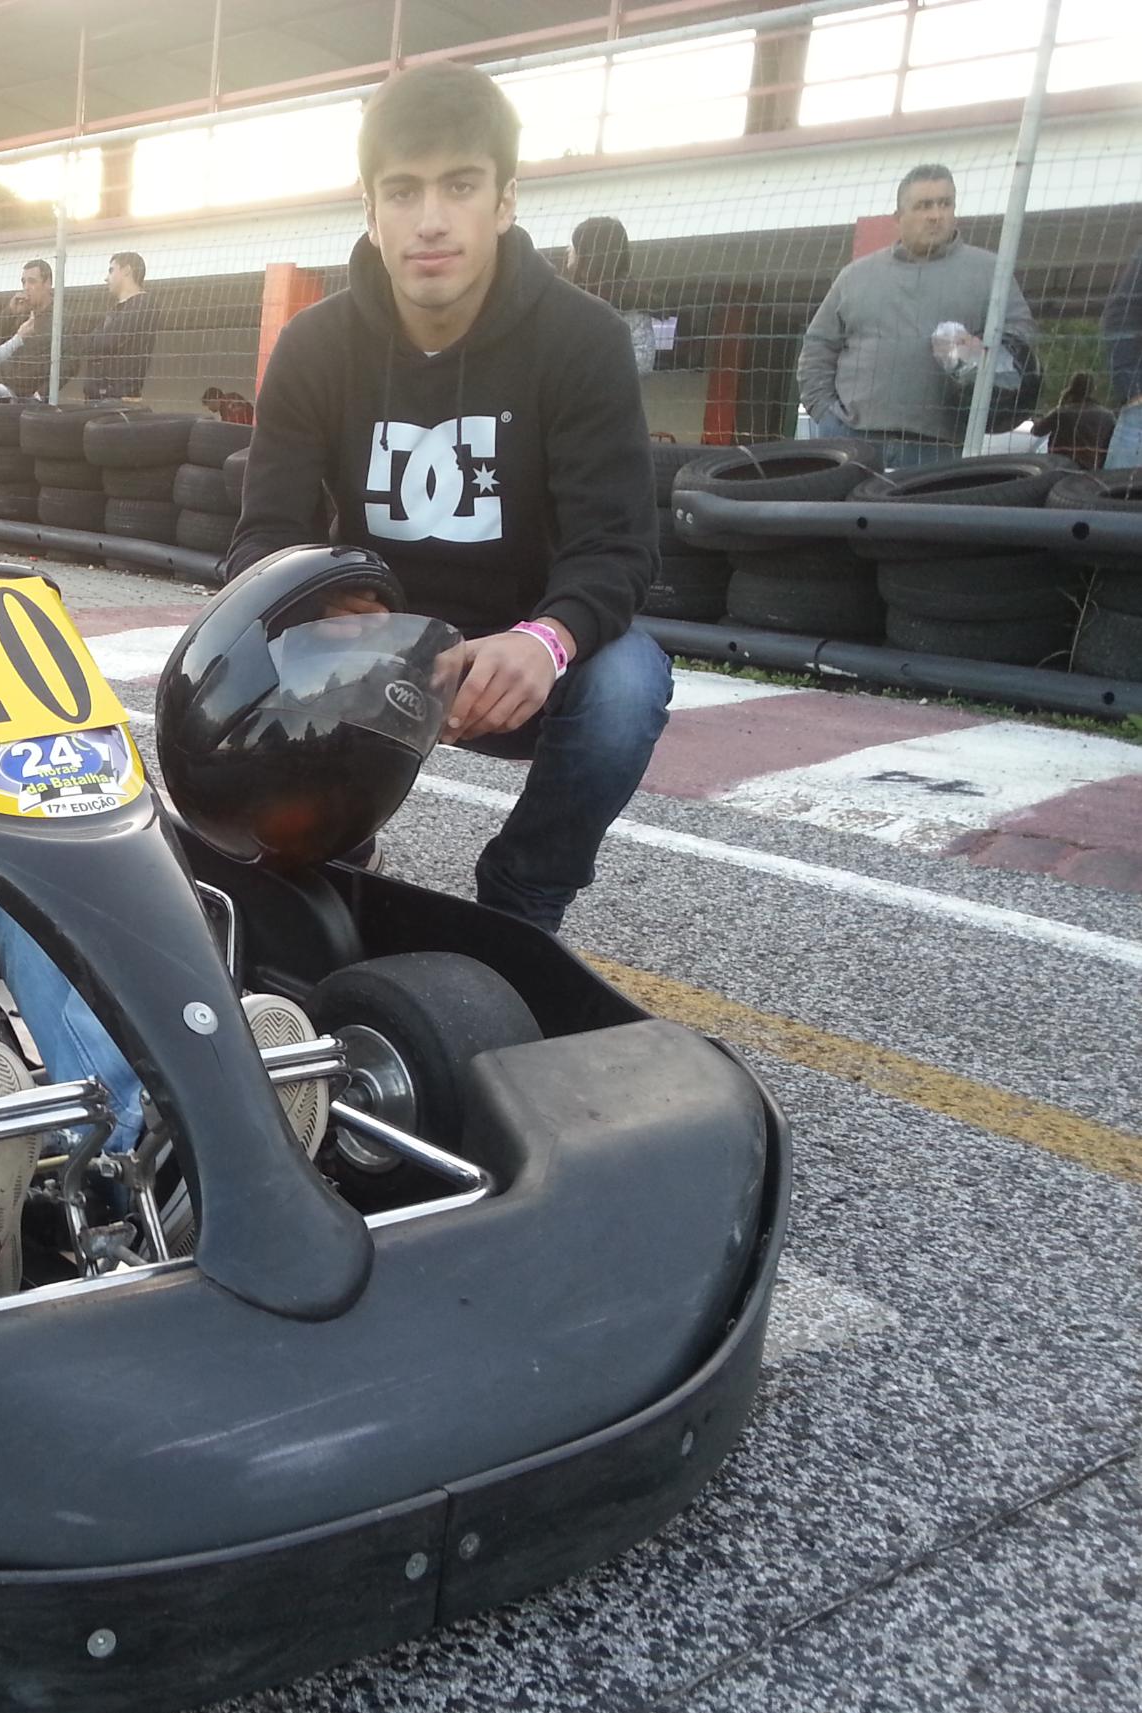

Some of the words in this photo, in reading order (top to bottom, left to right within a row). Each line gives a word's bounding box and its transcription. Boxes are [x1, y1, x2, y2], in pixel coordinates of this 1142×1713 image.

[364, 415, 503, 543] DC
[10, 736, 84, 778] 24
[26, 783, 48, 795] da
[49, 772, 109, 789] Batalha
[70, 796, 117, 813] EDIÇÃO
